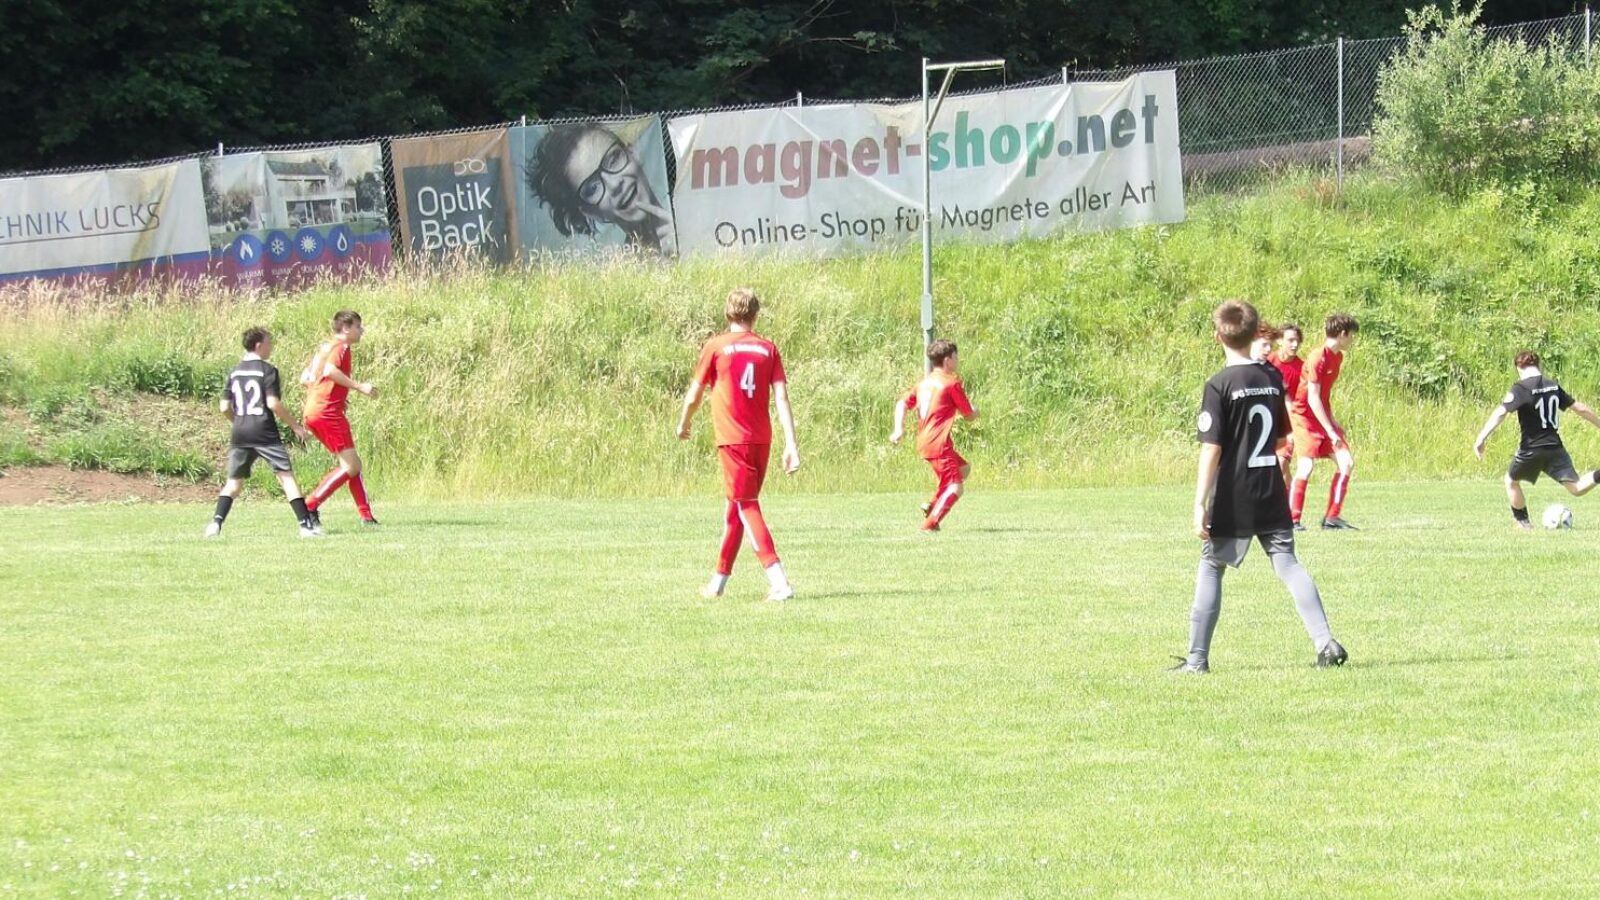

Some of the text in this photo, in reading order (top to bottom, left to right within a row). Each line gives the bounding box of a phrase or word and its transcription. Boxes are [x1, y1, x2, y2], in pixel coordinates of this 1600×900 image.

[690, 94, 1159, 200] magnet-shop.net
[79, 201, 161, 232] LUCKS
[417, 181, 493, 221] Optik
[715, 180, 1157, 247] Online-Shop fü Magnete aller Art
[421, 214, 494, 250] Back
[231, 378, 264, 417] 12
[739, 361, 757, 399] 4
[1534, 394, 1561, 430] 10
[1247, 403, 1277, 469] 2
